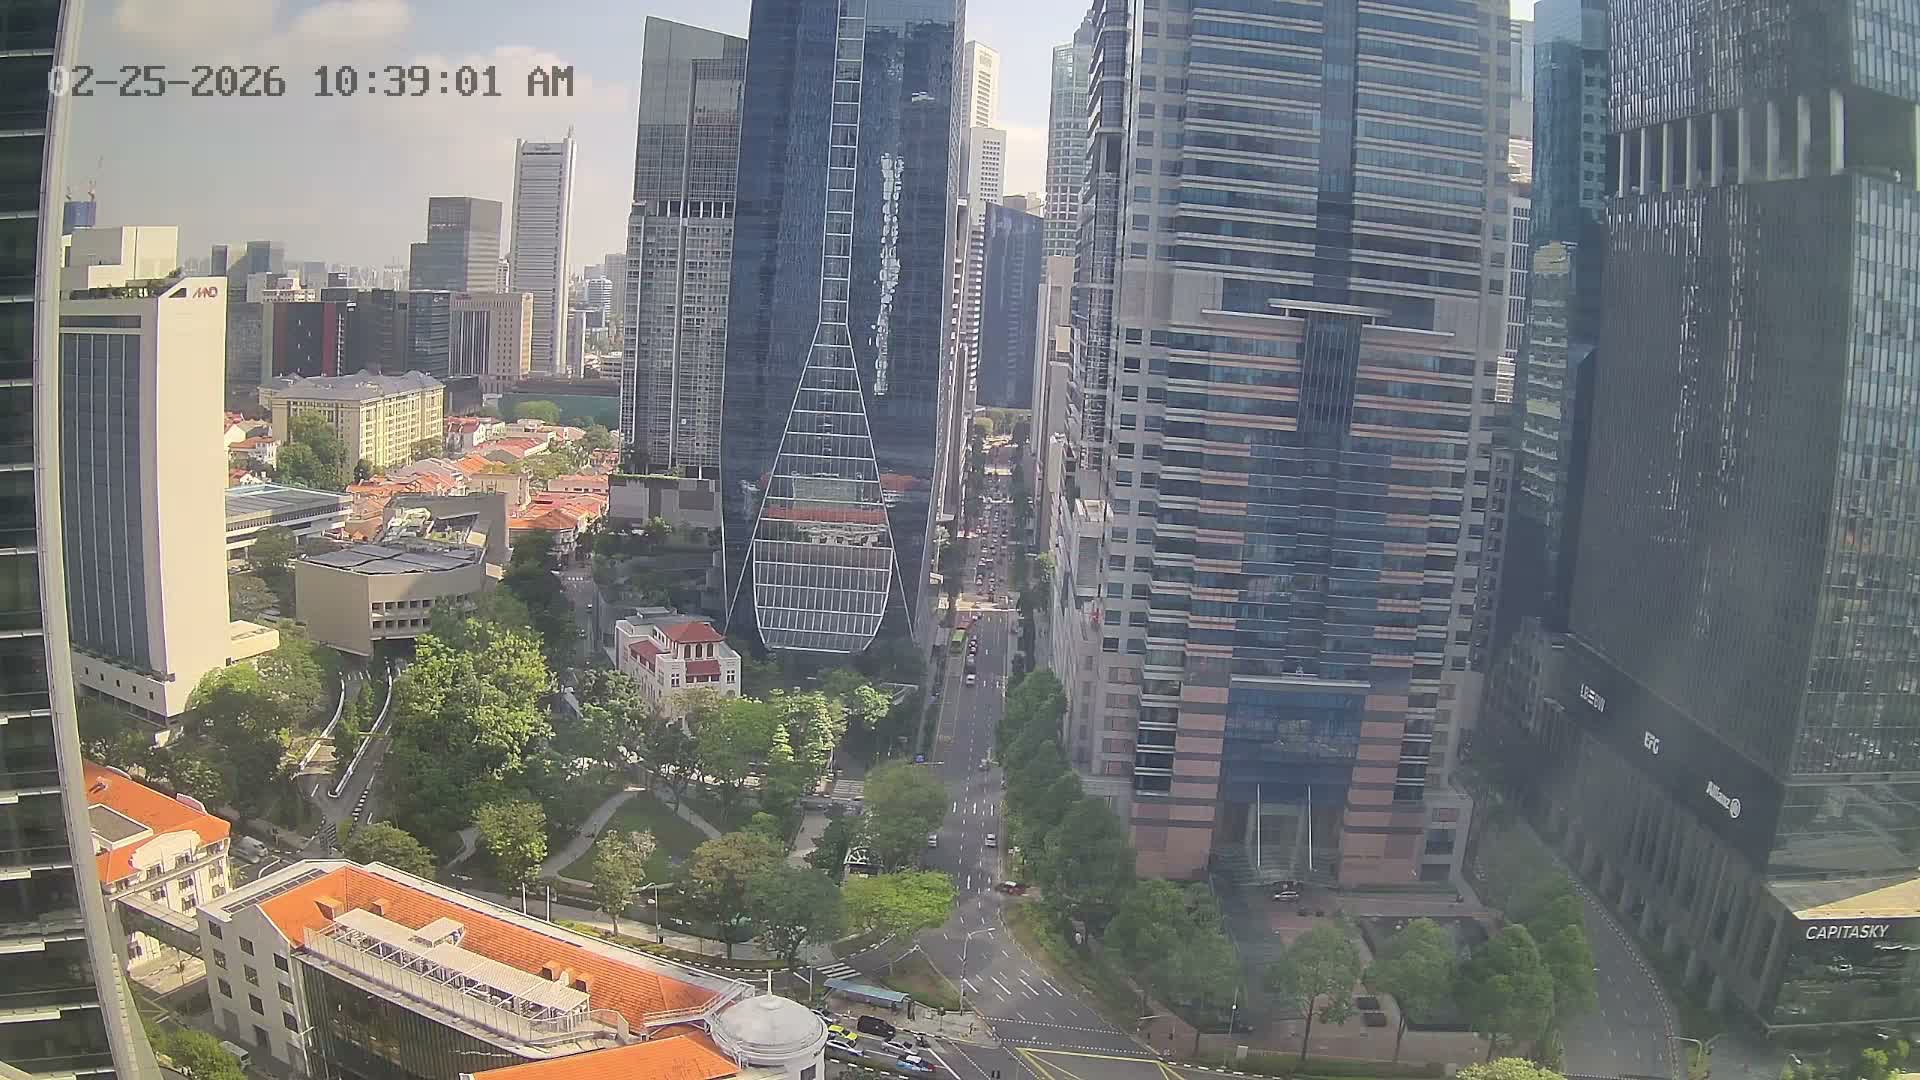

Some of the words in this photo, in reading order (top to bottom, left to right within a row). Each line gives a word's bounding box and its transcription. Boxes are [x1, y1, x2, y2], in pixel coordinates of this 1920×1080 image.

[1644, 731, 1660, 754] EFG
[1706, 781, 1731, 809] Allianz
[1805, 924, 1889, 940] CAPITASKY
